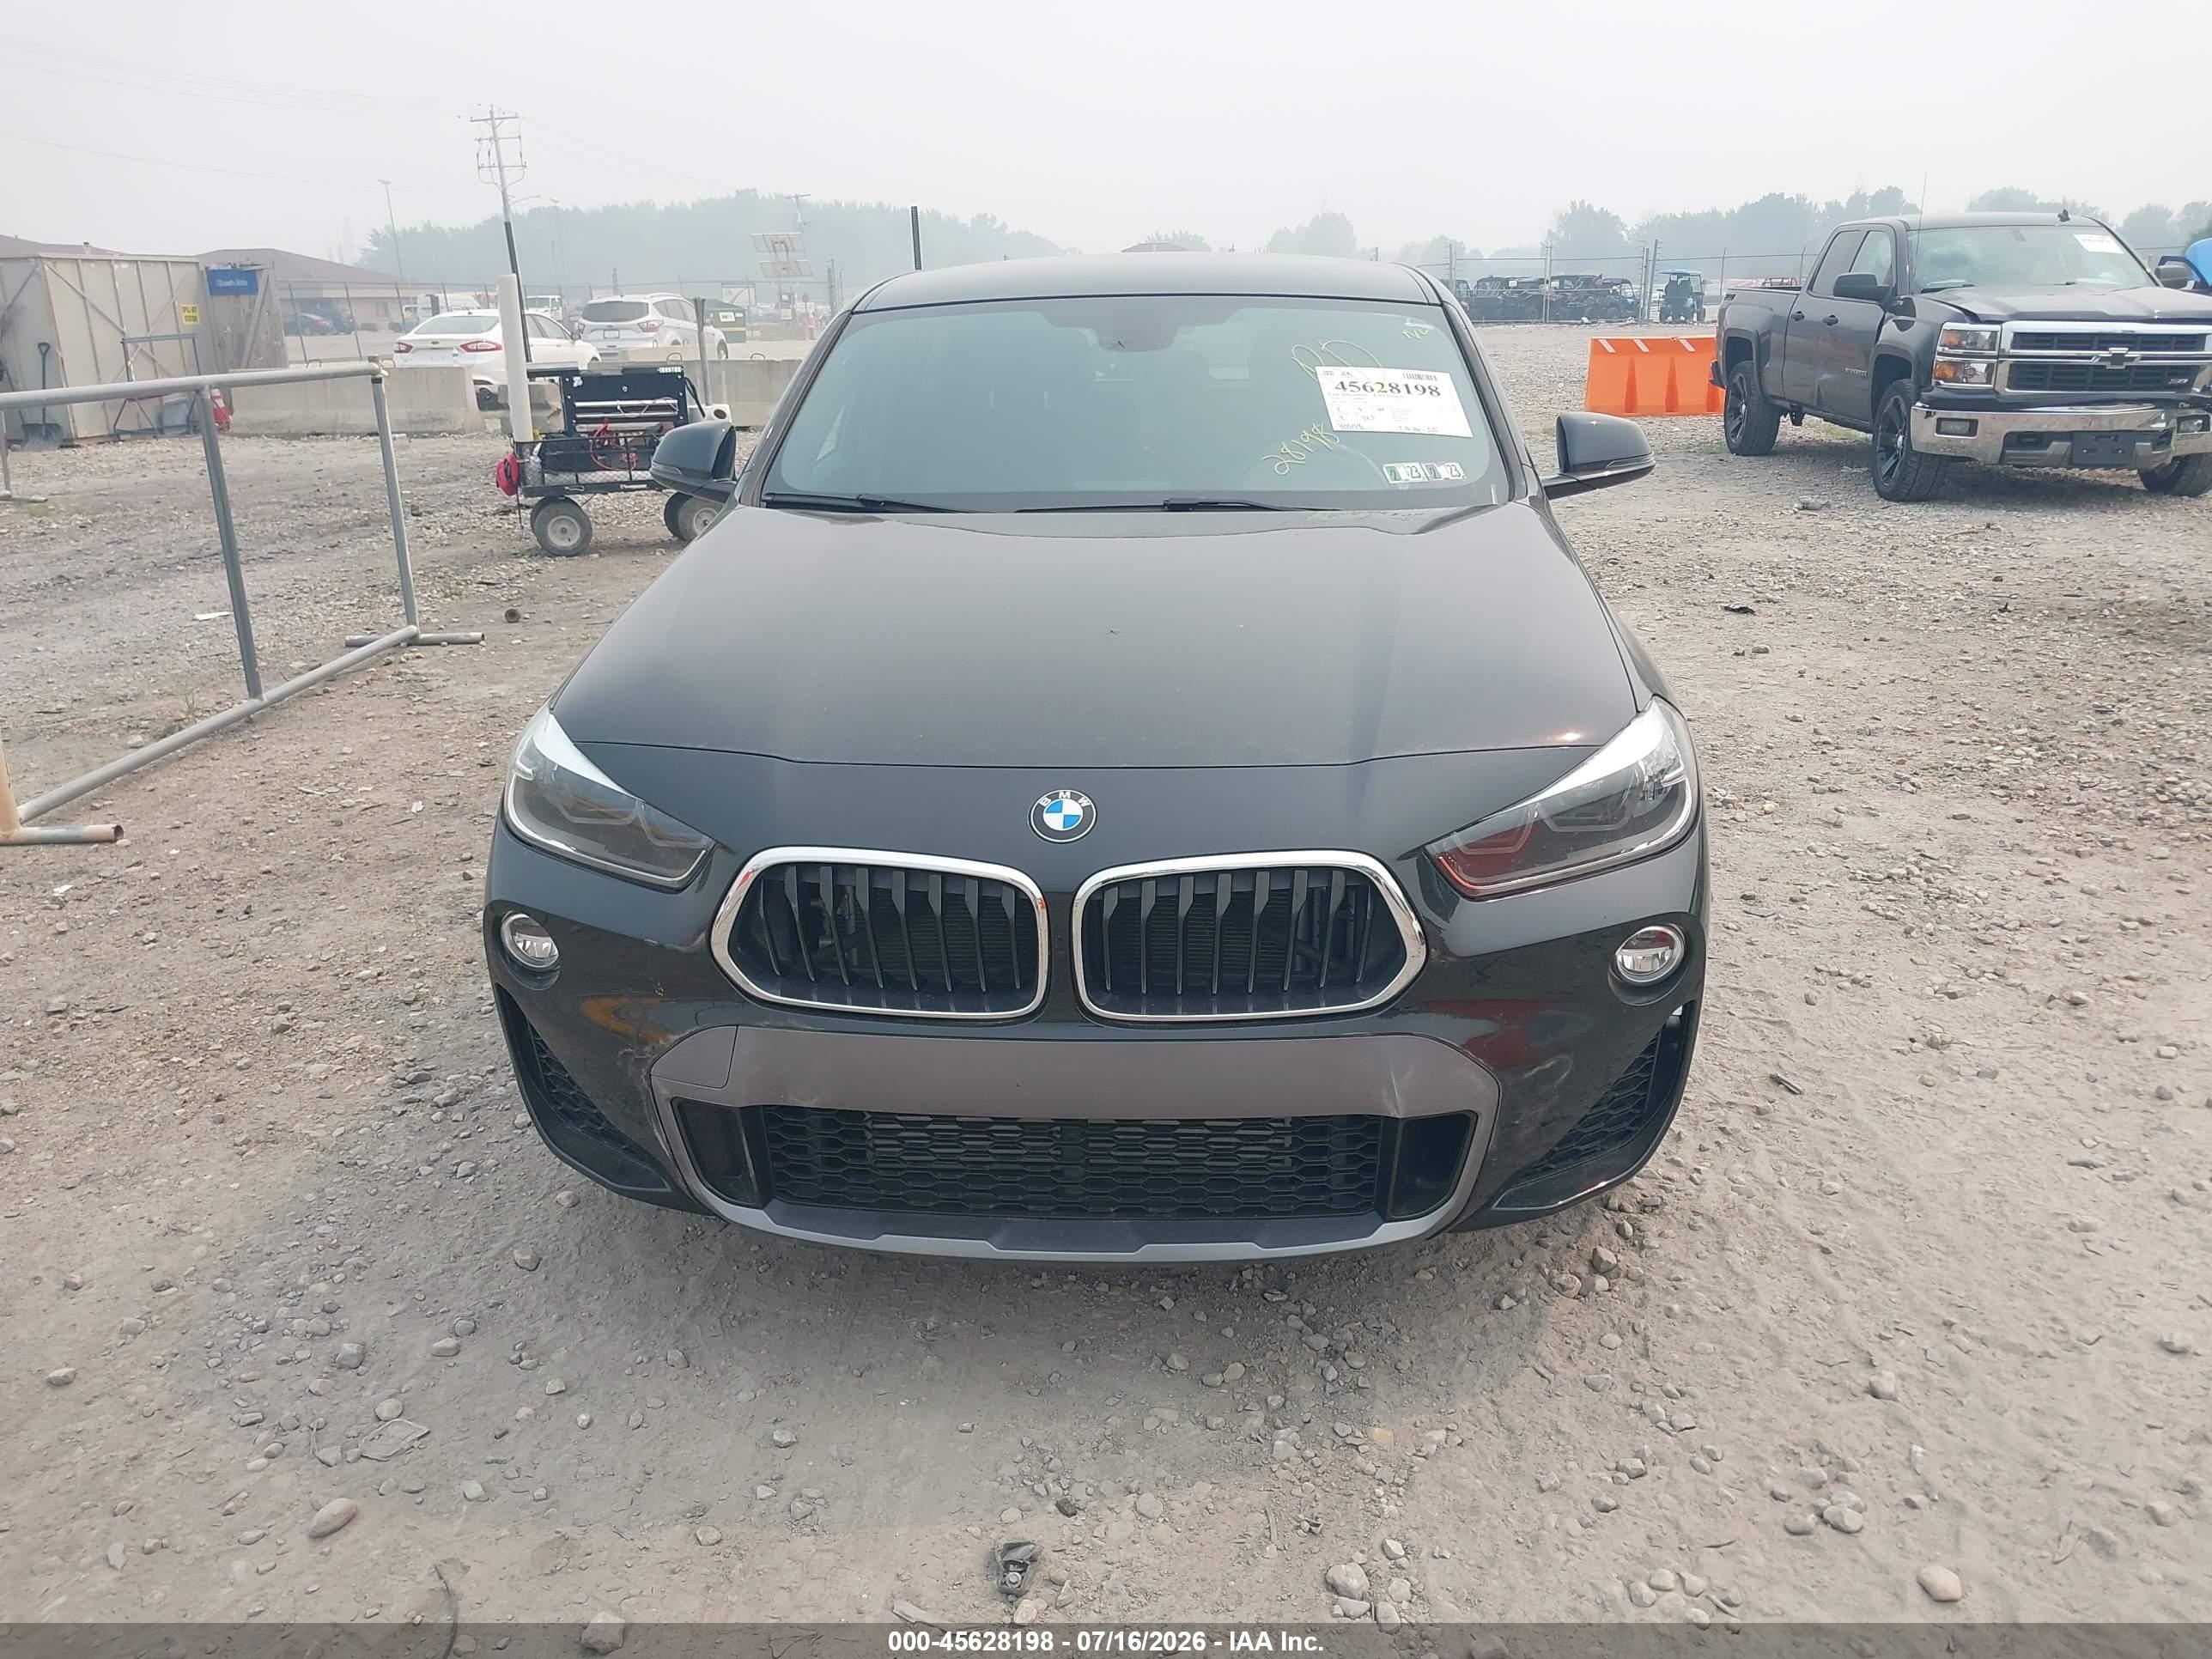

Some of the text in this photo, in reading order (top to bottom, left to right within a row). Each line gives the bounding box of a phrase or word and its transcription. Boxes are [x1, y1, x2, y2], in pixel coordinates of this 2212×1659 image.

[1334, 380, 1441, 398] 45628198
[1261, 422, 1340, 476] 28198
[1039, 791, 1091, 807] BMW
